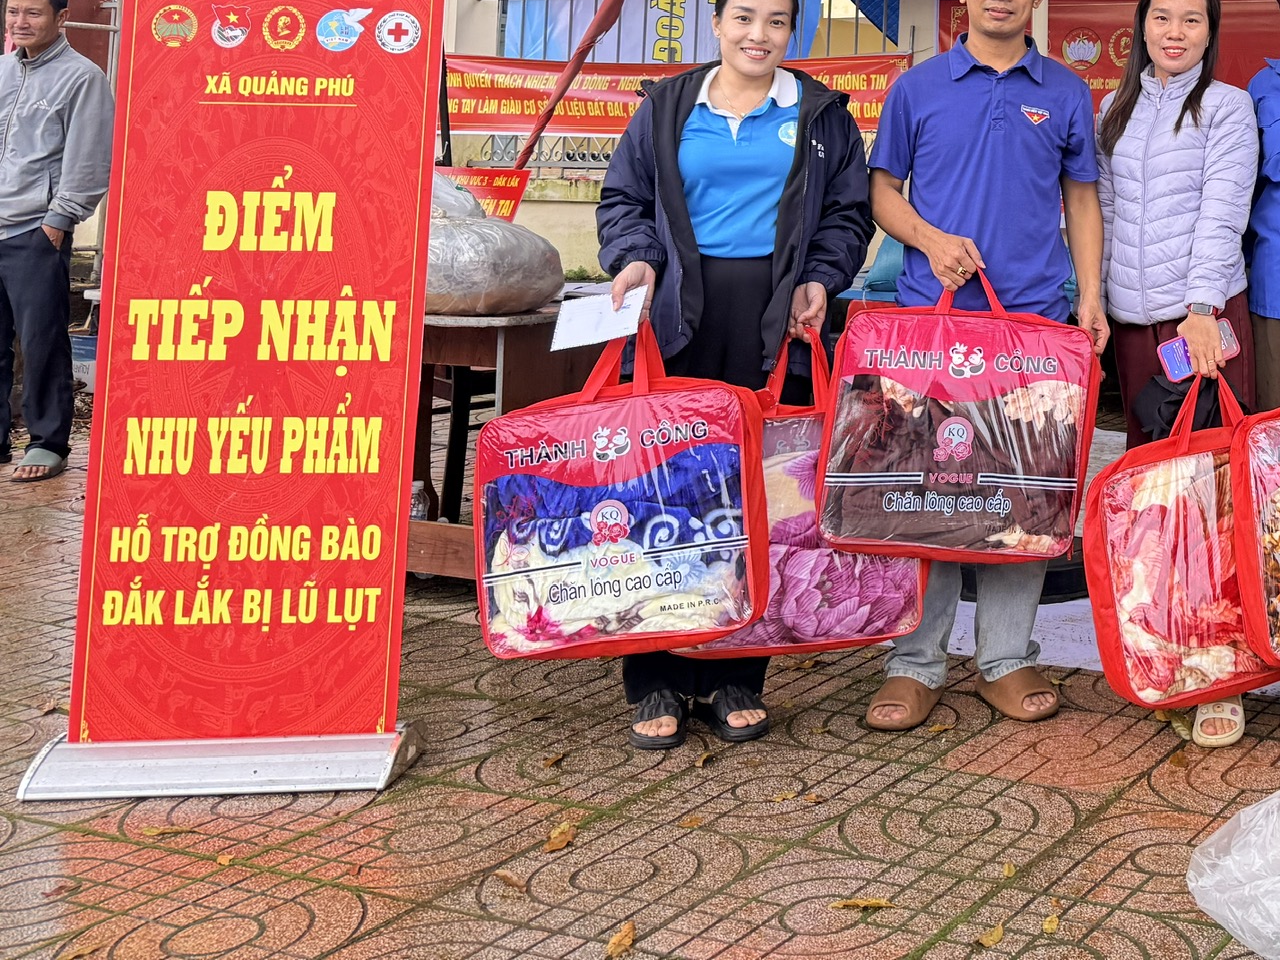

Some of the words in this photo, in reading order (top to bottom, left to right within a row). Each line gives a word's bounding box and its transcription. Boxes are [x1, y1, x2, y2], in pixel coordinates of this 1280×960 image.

[204, 71, 232, 95] XÃ
[238, 69, 309, 96] QUẢNG
[315, 73, 355, 97] PHÚ
[494, 71, 524, 88] TRÁCH
[832, 71, 866, 90] THÔNG
[870, 74, 888, 90] TIN
[461, 98, 476, 114] TAY
[477, 96, 498, 114] LÀM
[500, 97, 521, 115] GIÀU
[524, 99, 537, 115] CƠ
[566, 98, 585, 119] LIỆU
[587, 96, 605, 117] ĐẤT
[202, 165, 337, 252] ĐIỂM
[496, 199, 515, 217] TAI
[128, 276, 245, 361] TIẾP
[256, 285, 397, 377] NHẬN
[864, 345, 943, 370] THÀNH
[994, 348, 1058, 374] CÔNG
[123, 417, 197, 475] NHU
[207, 395, 272, 474] YẾU
[279, 392, 382, 474] PHẨM
[504, 440, 586, 469] THÀNH
[640, 419, 709, 448] CÔNG
[948, 427, 965, 439] KQ
[929, 472, 973, 484] VOGUE
[600, 509, 619, 522] KQ
[883, 491, 921, 513] Chăn
[924, 492, 955, 515] lông
[958, 497, 983, 512] cao
[985, 488, 1011, 517] cấp
[109, 513, 152, 563] HỖ
[161, 522, 220, 570] TRỢ
[227, 513, 311, 562] ĐỒNG
[320, 517, 382, 561] BÀO
[590, 553, 636, 568] VOGUE
[548, 582, 586, 605] Chăn
[590, 575, 621, 599] lông
[625, 573, 652, 590] cao
[655, 563, 682, 589] cấp
[102, 576, 166, 626] ĐẮK
[174, 575, 233, 626] LẮK
[242, 588, 272, 632] BỊ
[281, 580, 318, 624] LŨ
[326, 587, 382, 631] LỤT
[659, 602, 685, 612] MADE
[686, 601, 696, 610] IN
